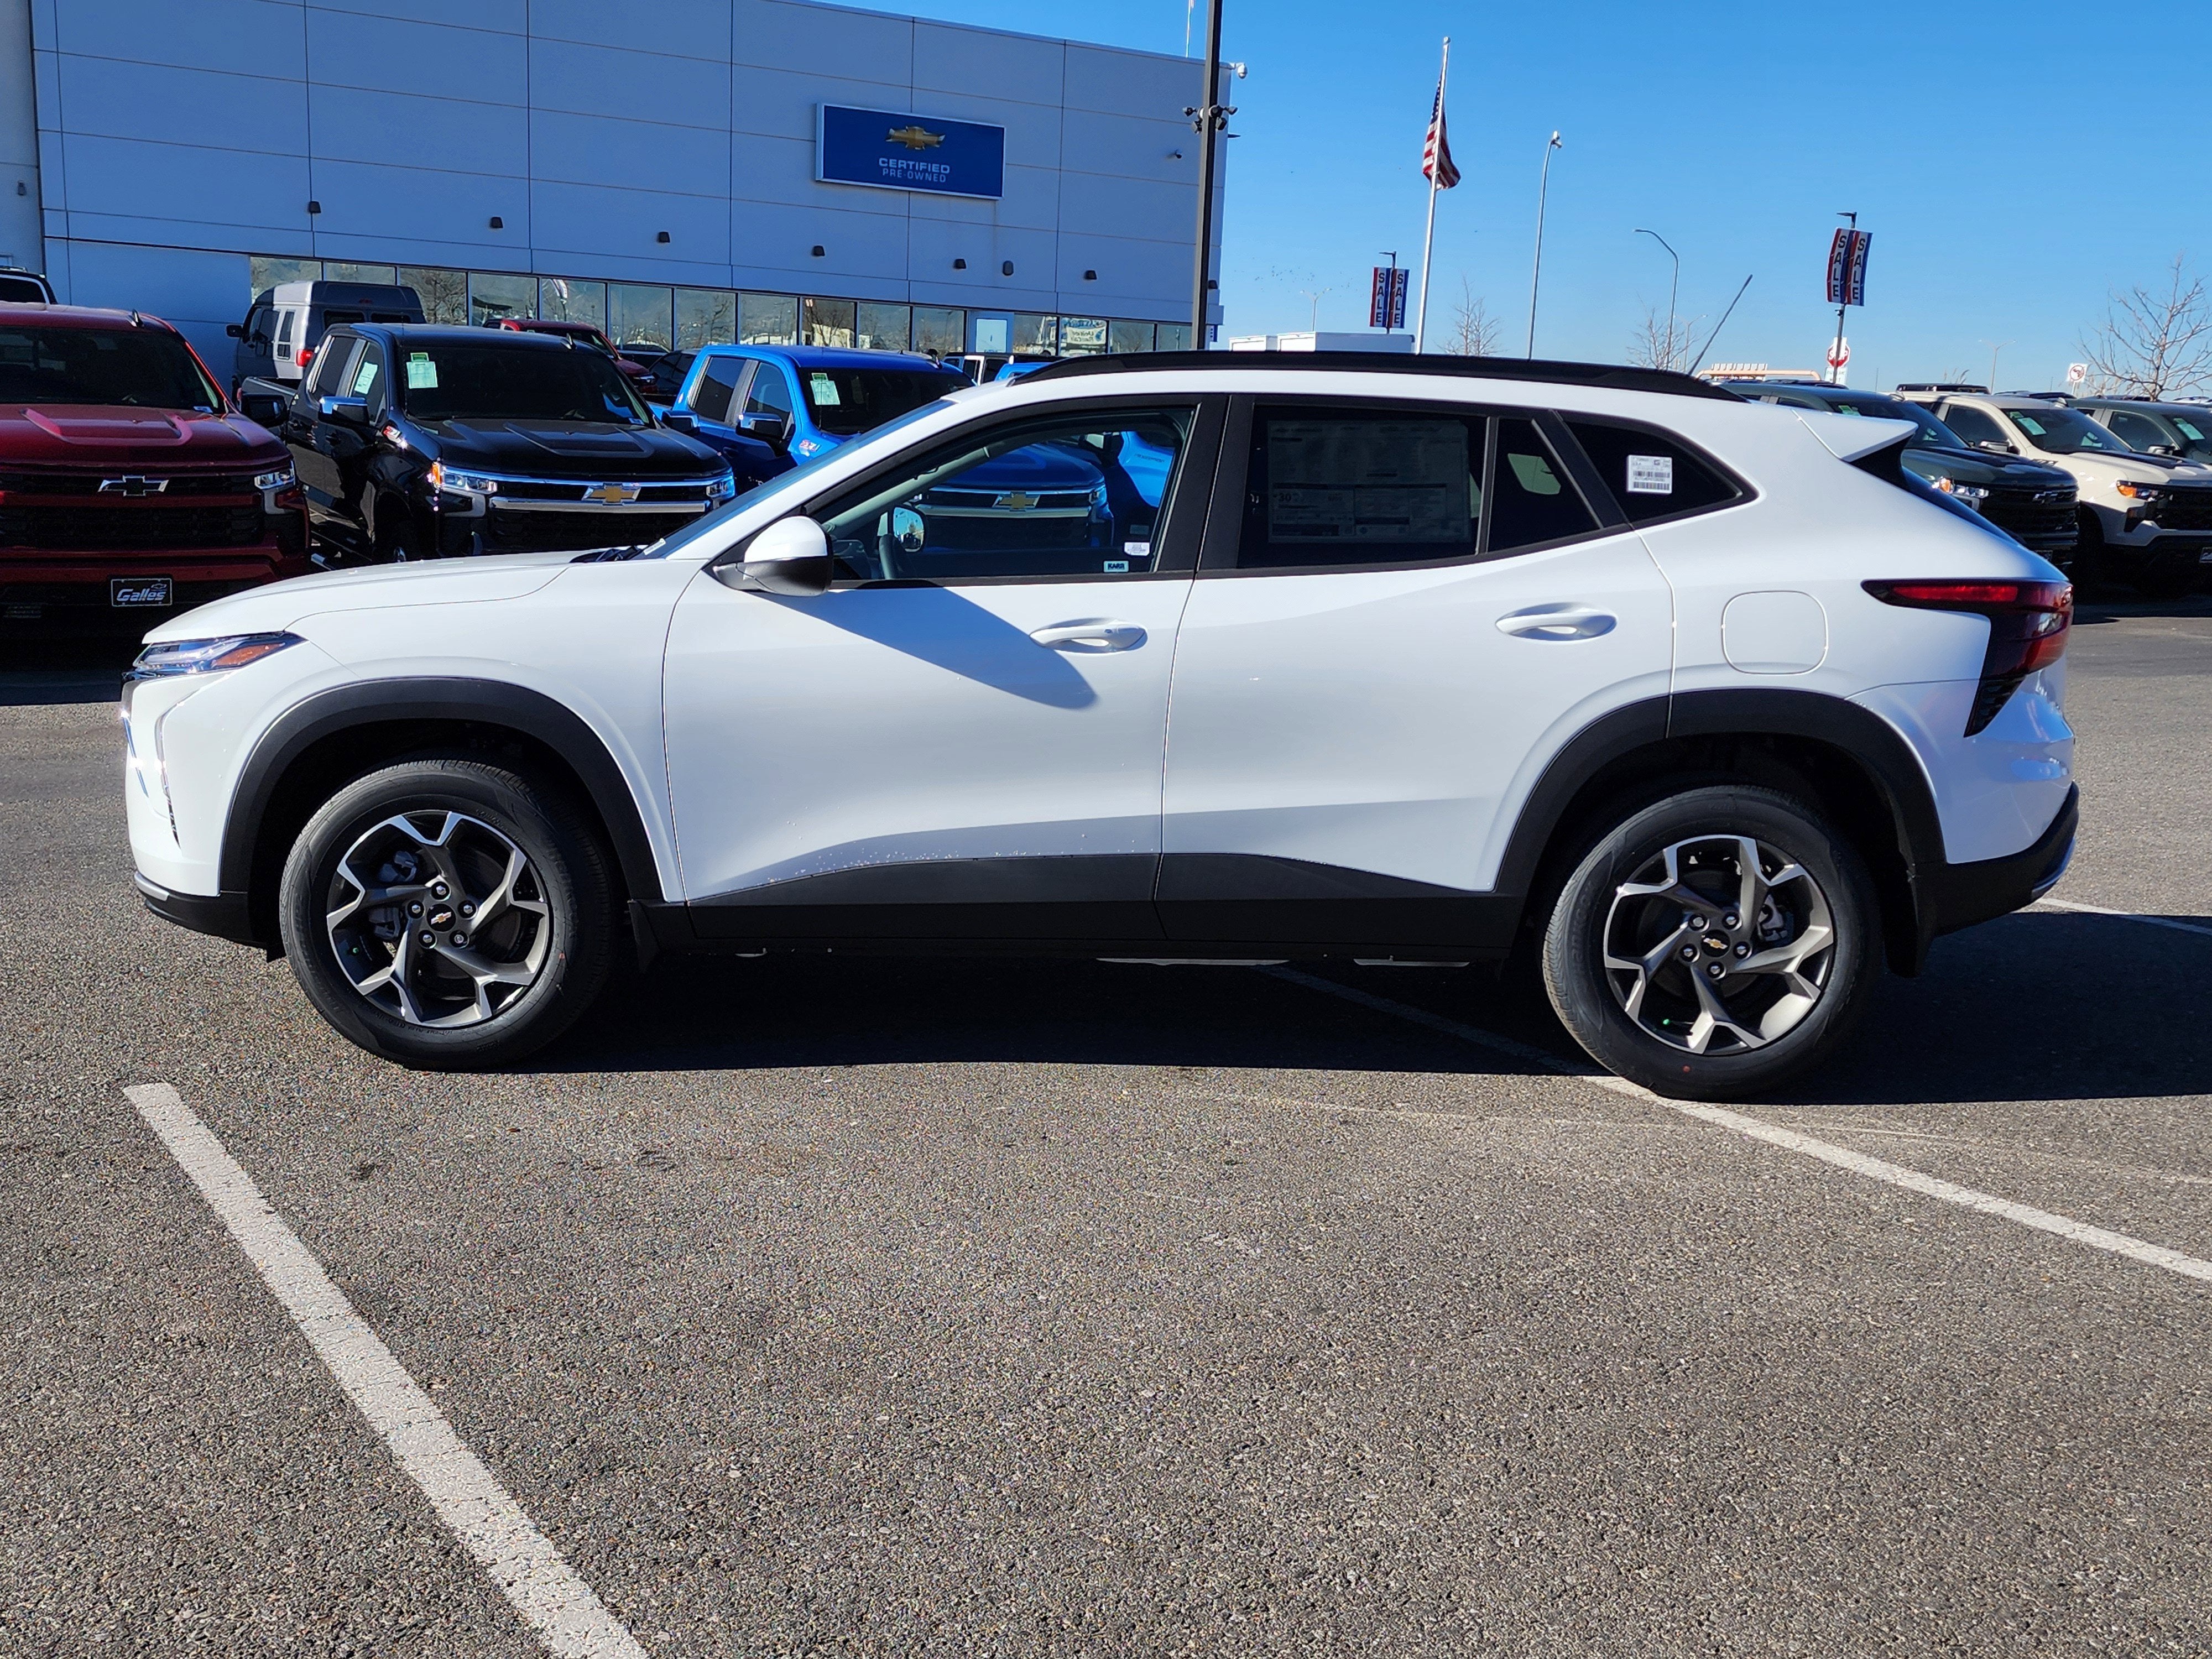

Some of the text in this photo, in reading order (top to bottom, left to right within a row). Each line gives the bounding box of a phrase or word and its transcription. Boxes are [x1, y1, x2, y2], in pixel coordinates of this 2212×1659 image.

[879, 158, 950, 174] CERTIFIED
[882, 168, 947, 183] PRE-OWNED
[1833, 234, 1847, 298] SALE
[1852, 238, 1866, 300] SALE
[1375, 273, 1385, 323] SALE
[1394, 273, 1404, 324] SALE
[116, 588, 166, 602] Galles
